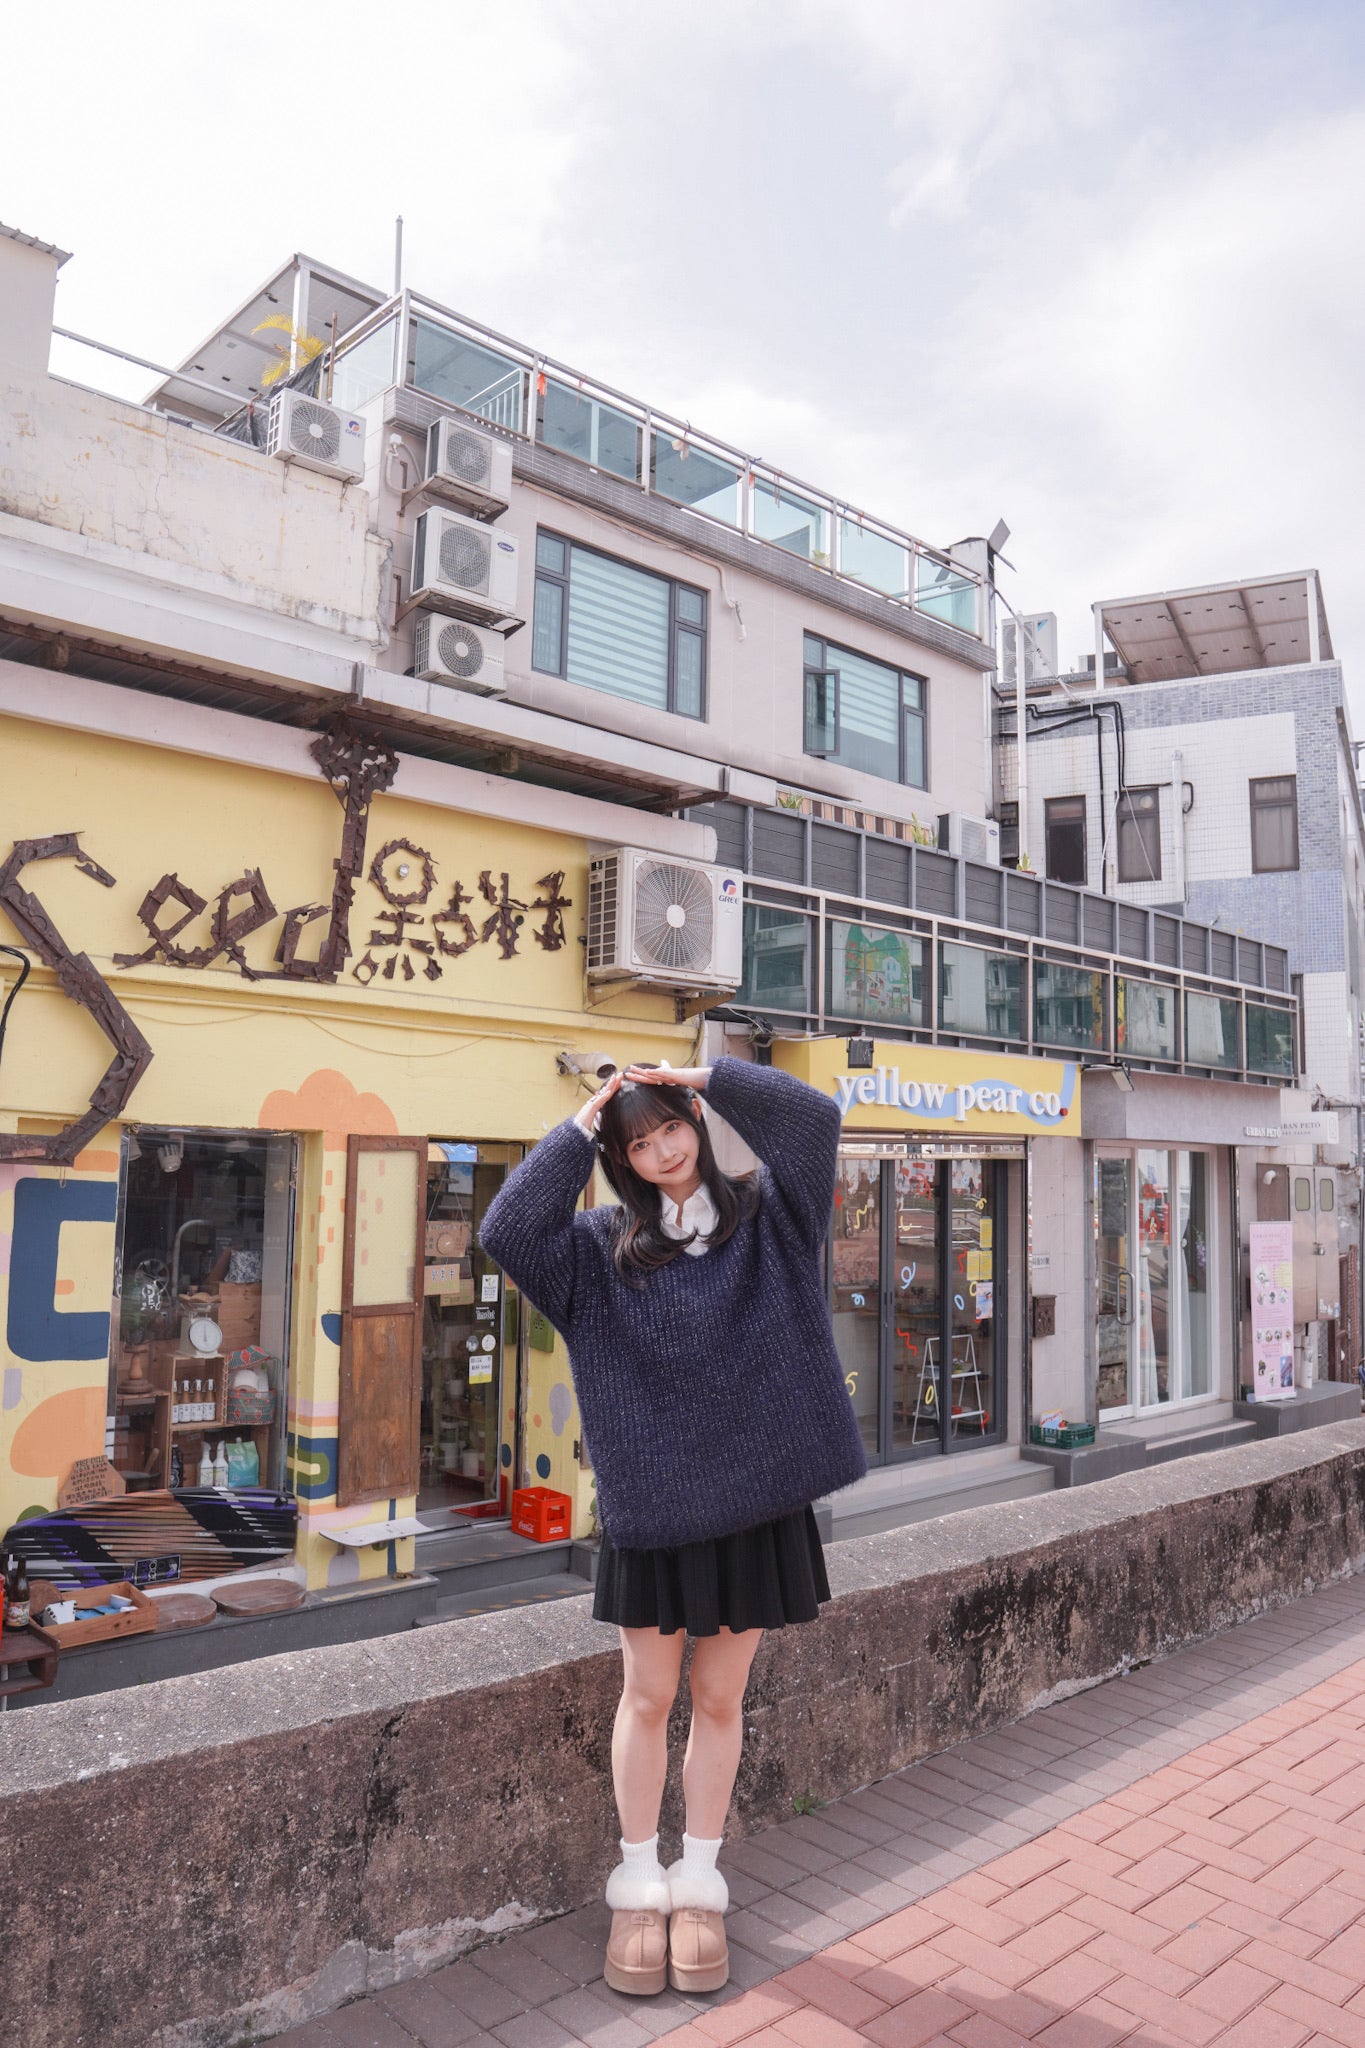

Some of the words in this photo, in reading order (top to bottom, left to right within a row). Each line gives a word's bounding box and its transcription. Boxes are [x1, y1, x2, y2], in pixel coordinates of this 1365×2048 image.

[718, 894, 740, 905] GREE
[0, 715, 400, 1166] Seed
[834, 1065, 948, 1116] yellow
[954, 1084, 1023, 1122] pear
[1245, 1126, 1266, 1137] URBAN
